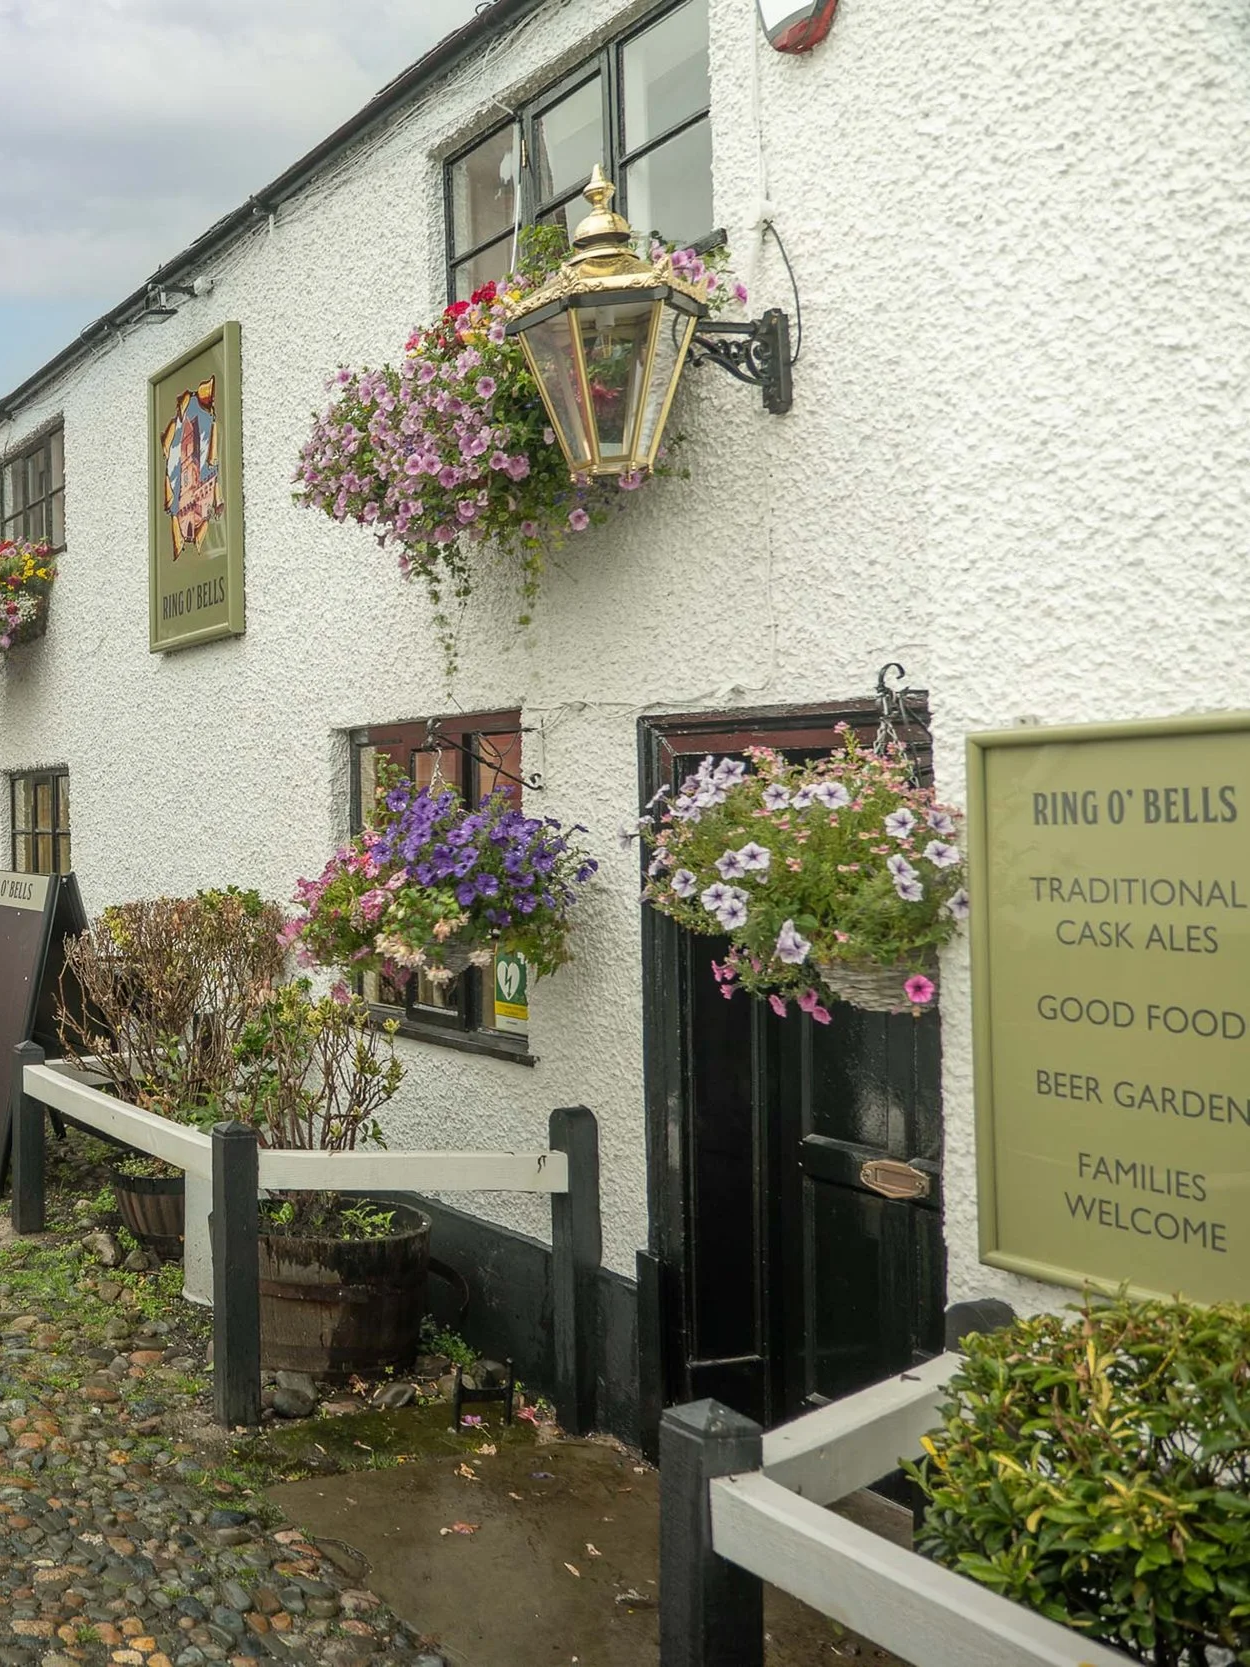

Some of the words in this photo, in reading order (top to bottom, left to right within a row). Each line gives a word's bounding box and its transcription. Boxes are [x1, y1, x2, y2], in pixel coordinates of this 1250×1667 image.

[163, 591, 184, 620] RING
[197, 576, 225, 610] BELLS
[1032, 790, 1099, 827] RING
[1143, 785, 1238, 825] BELLS
[9, 880, 33, 900] BELLS
[1029, 876, 1248, 909] TRADITIONAL
[1056, 919, 1135, 951] CASK
[1145, 924, 1219, 955] ALES
[1037, 995, 1135, 1029] GOOD
[1148, 1004, 1246, 1040] FOOD
[1036, 1069, 1103, 1104] BEER
[1113, 1081, 1250, 1127] GARDEN
[1078, 1152, 1207, 1203] FAMILIES
[1064, 1191, 1228, 1254] WELCOME
